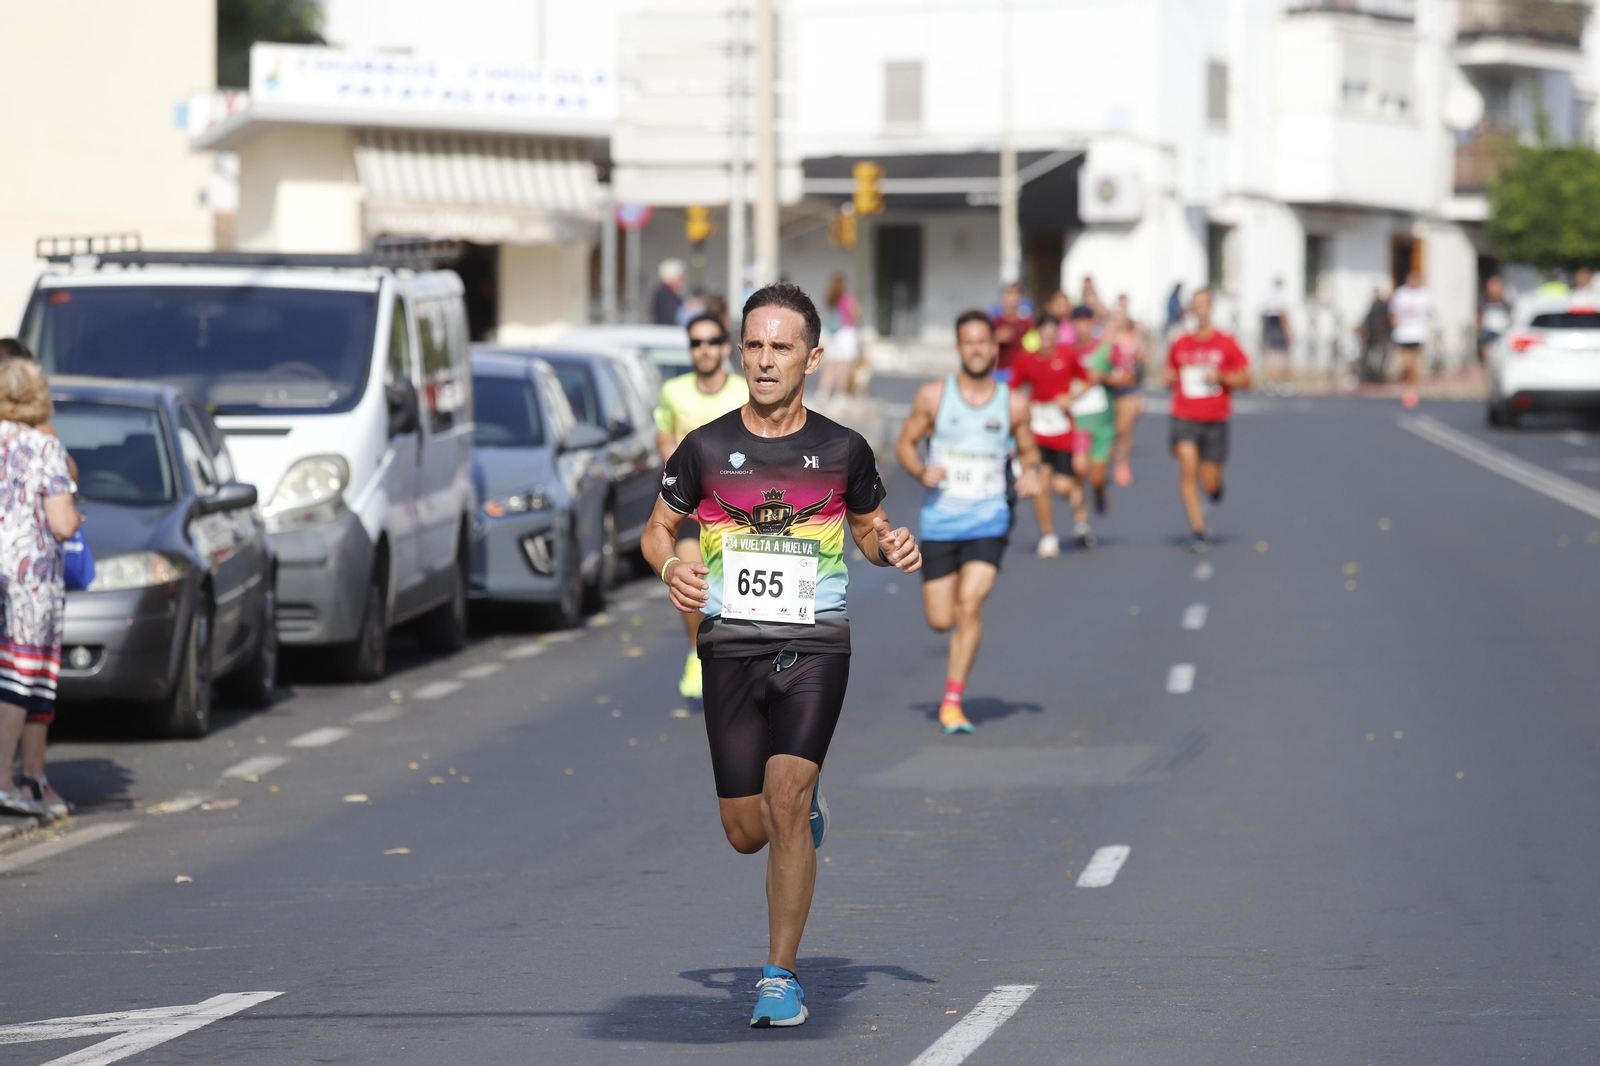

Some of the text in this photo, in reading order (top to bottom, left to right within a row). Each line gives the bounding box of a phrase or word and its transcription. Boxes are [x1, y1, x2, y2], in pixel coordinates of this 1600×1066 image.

[740, 538, 771, 552] VUELTA
[773, 541, 780, 552] A
[782, 541, 813, 555] HUELVA
[737, 568, 784, 598] 655
